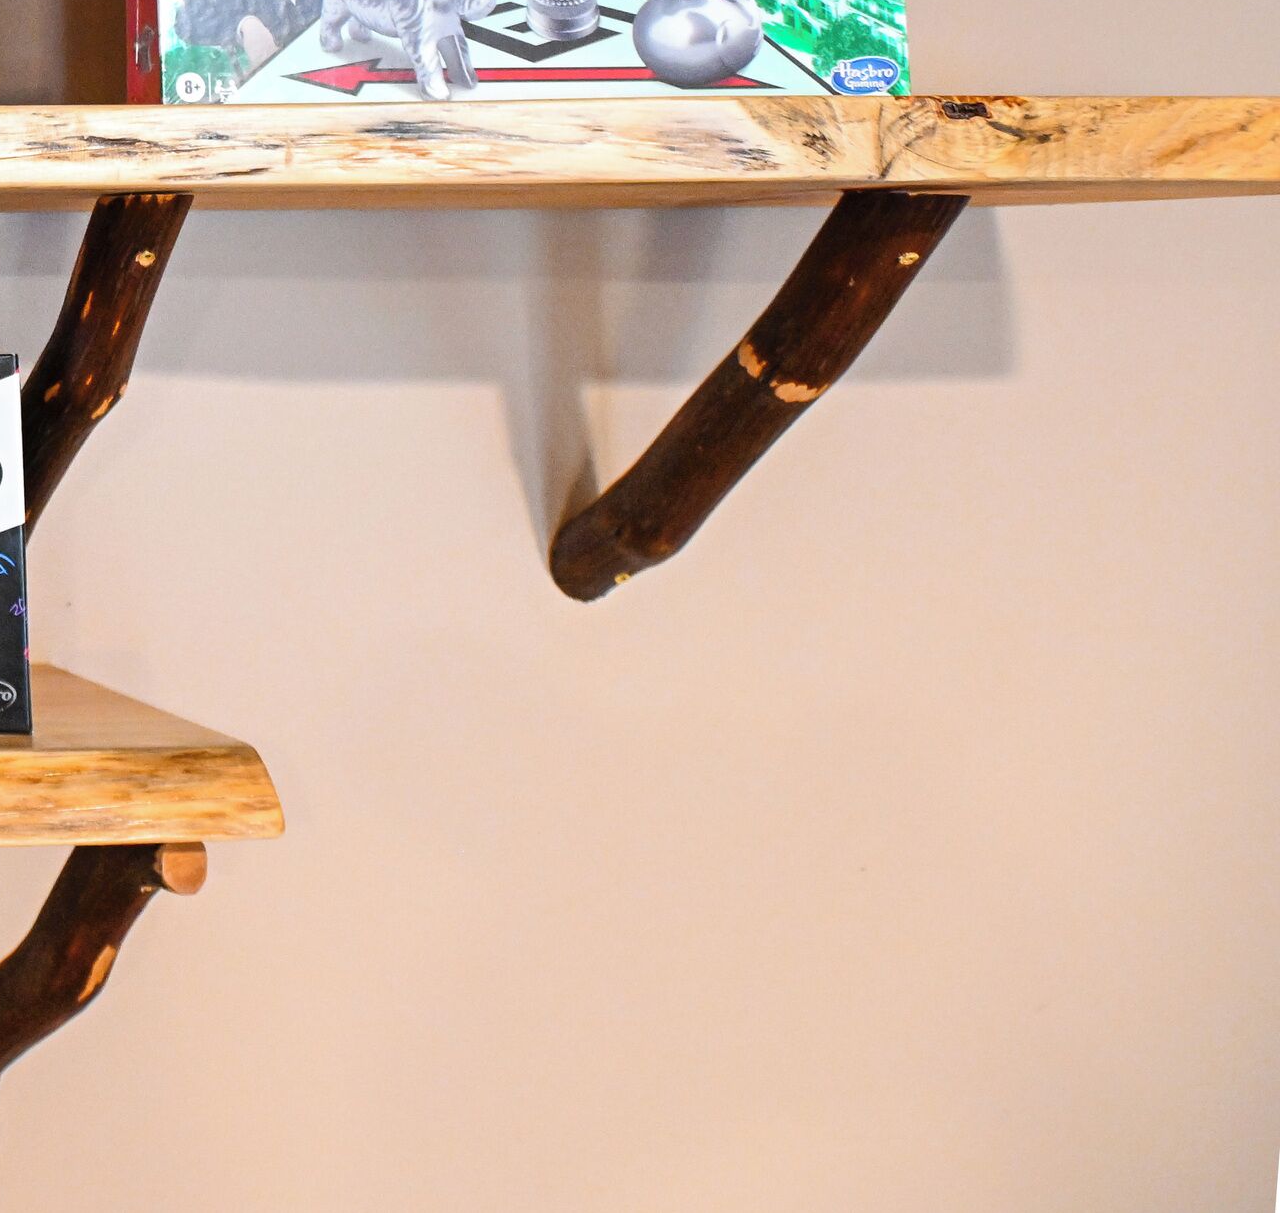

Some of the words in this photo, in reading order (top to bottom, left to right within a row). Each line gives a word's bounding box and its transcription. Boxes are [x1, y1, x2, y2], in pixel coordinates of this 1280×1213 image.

[833, 61, 894, 81] Hasbro
[184, 80, 201, 95] 8+
[844, 76, 886, 92] Gaming
